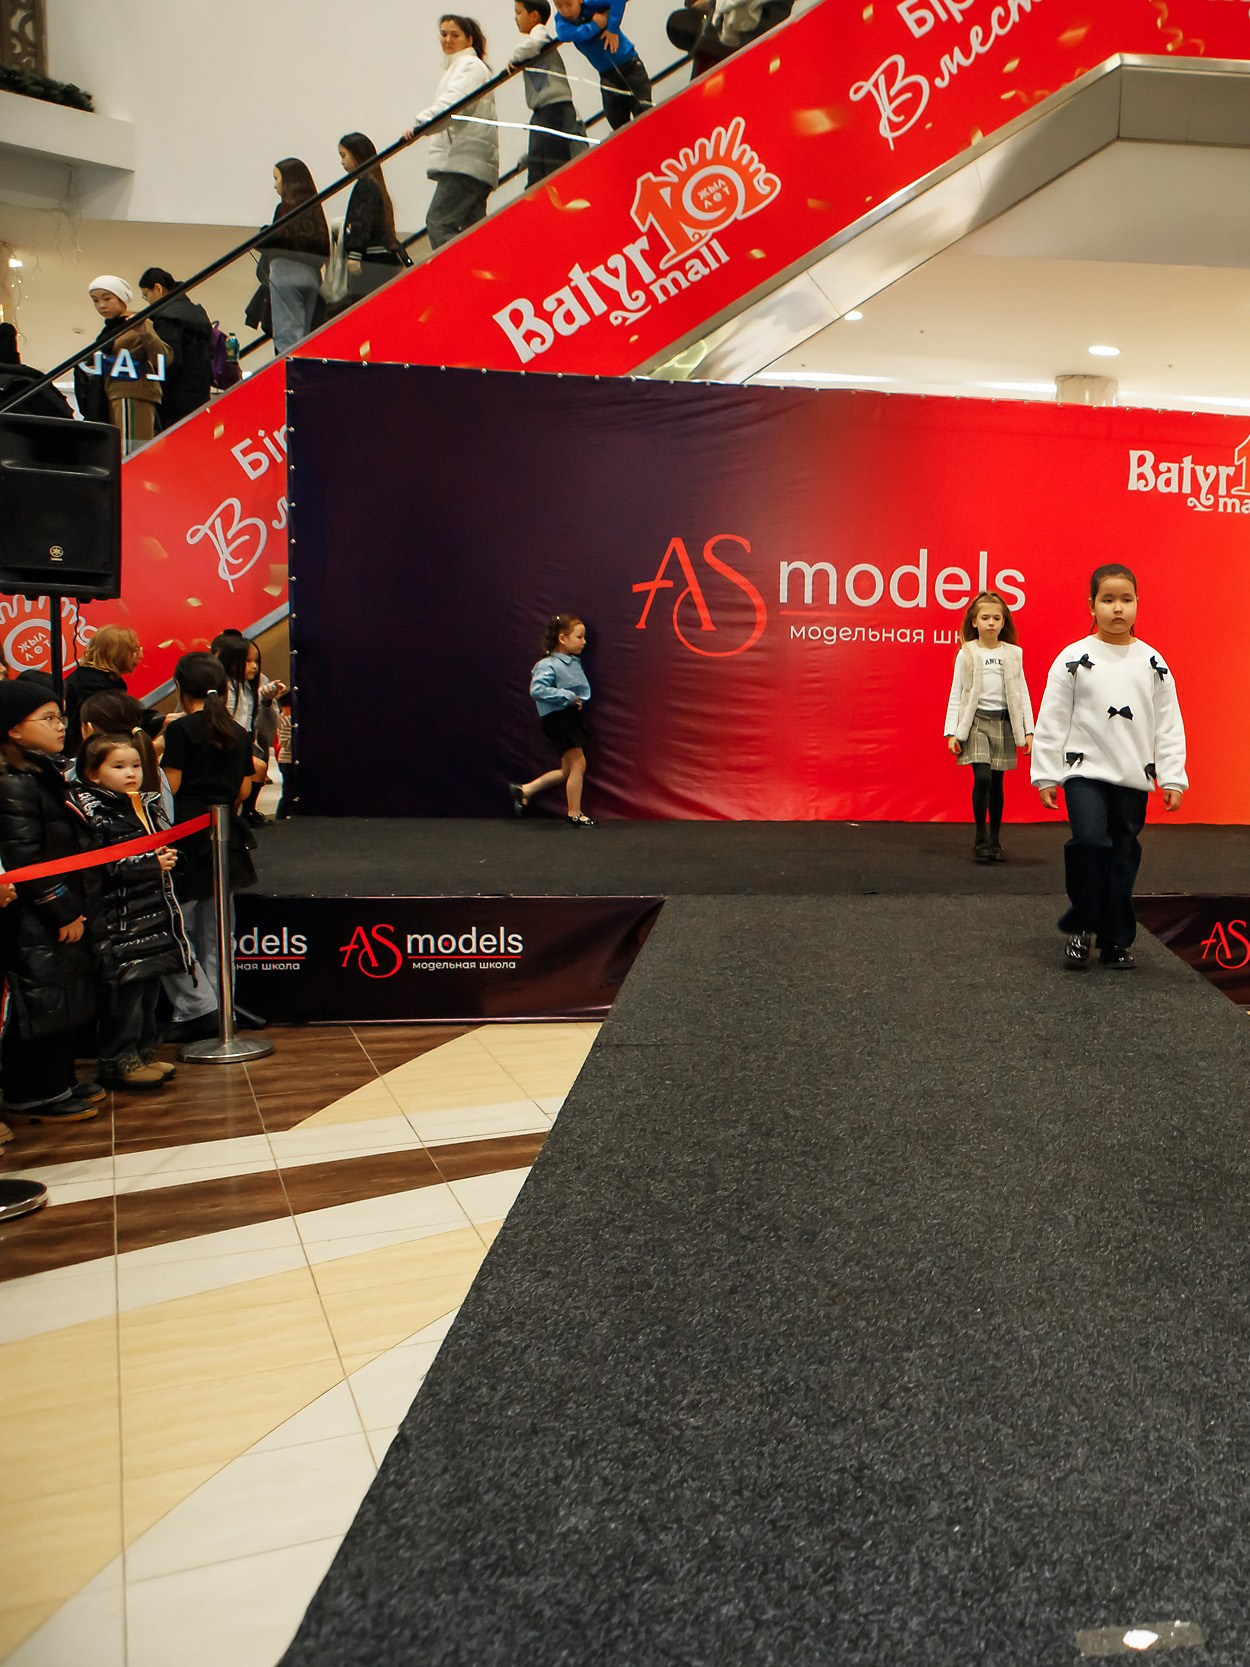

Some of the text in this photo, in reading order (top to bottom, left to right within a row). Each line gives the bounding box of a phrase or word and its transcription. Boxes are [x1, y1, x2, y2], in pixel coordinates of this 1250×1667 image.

[492, 235, 657, 364] Batyr
[649, 238, 730, 304] mall
[1128, 449, 1236, 512] Batyr
[632, 533, 1026, 657] AS models
[17, 632, 47, 653] ЖЫЛ
[790, 624, 925, 646] модельная
[231, 923, 524, 979] dels AS models
[412, 961, 517, 972] модельная школа
